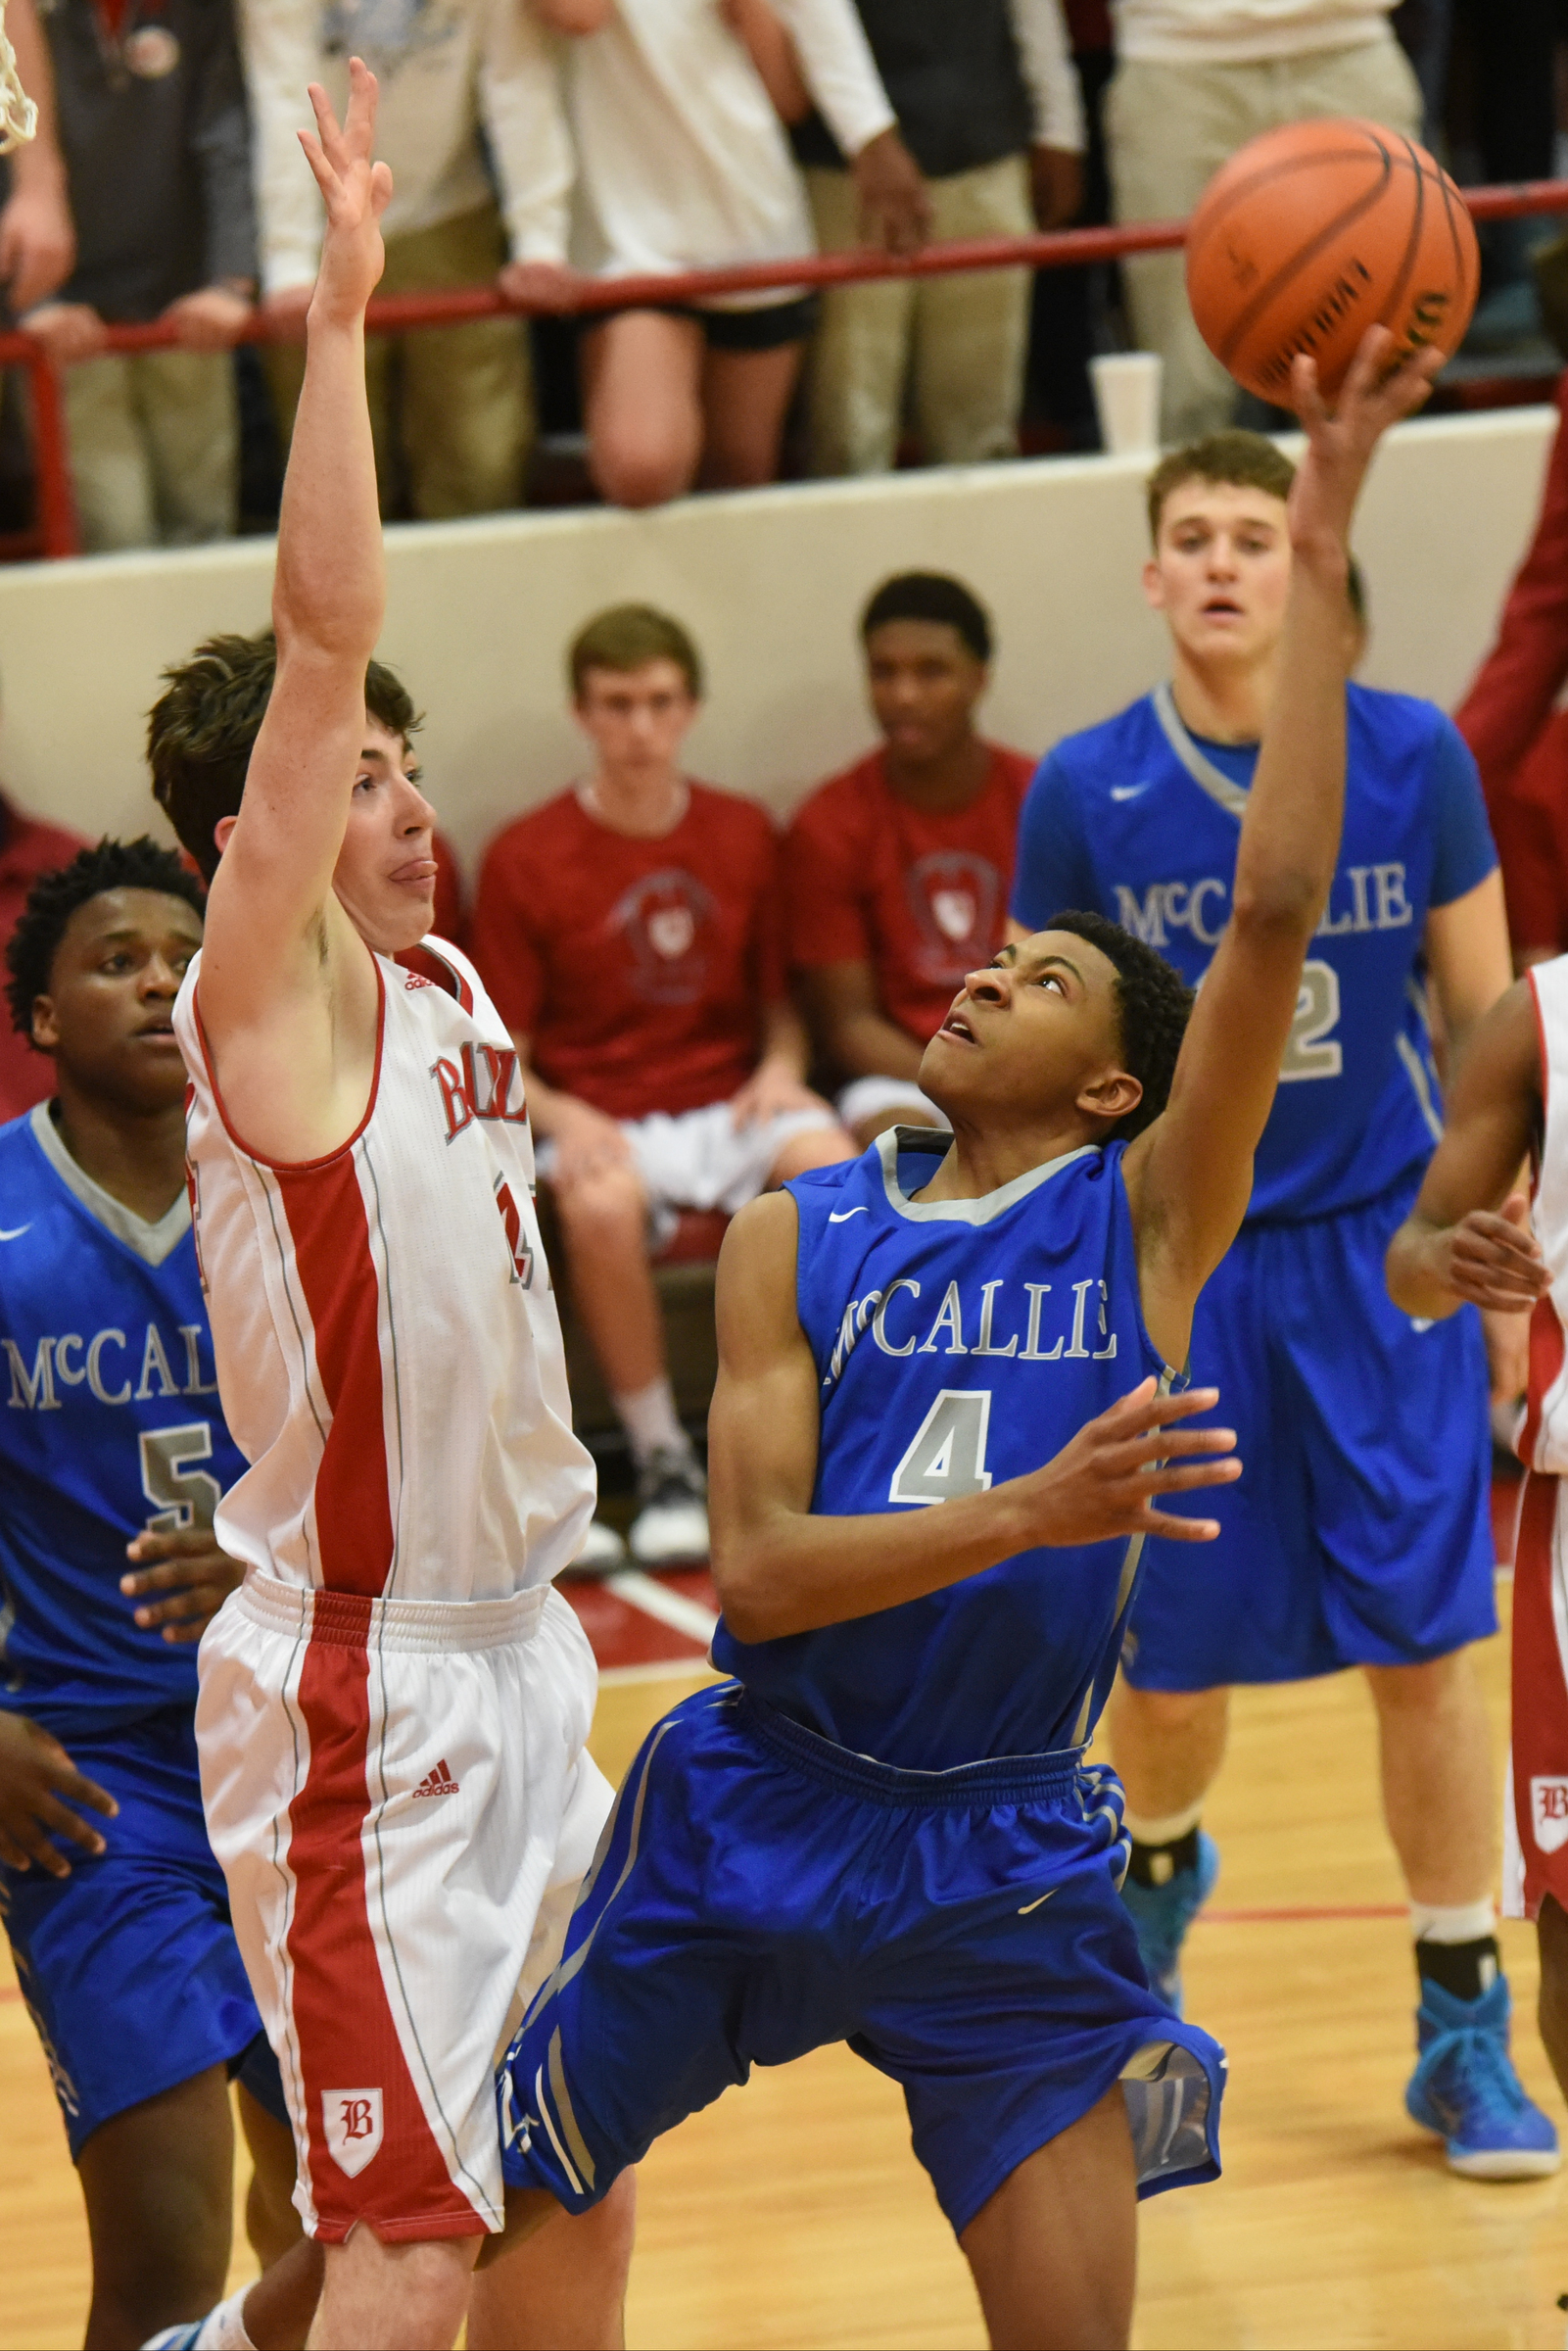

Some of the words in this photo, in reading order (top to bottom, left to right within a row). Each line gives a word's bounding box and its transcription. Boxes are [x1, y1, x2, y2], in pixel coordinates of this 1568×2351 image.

[138, 1421, 222, 1532] 5
[888, 1389, 992, 1505] 4
[412, 1783, 459, 1799] adidas
[340, 2099, 373, 2146] B
